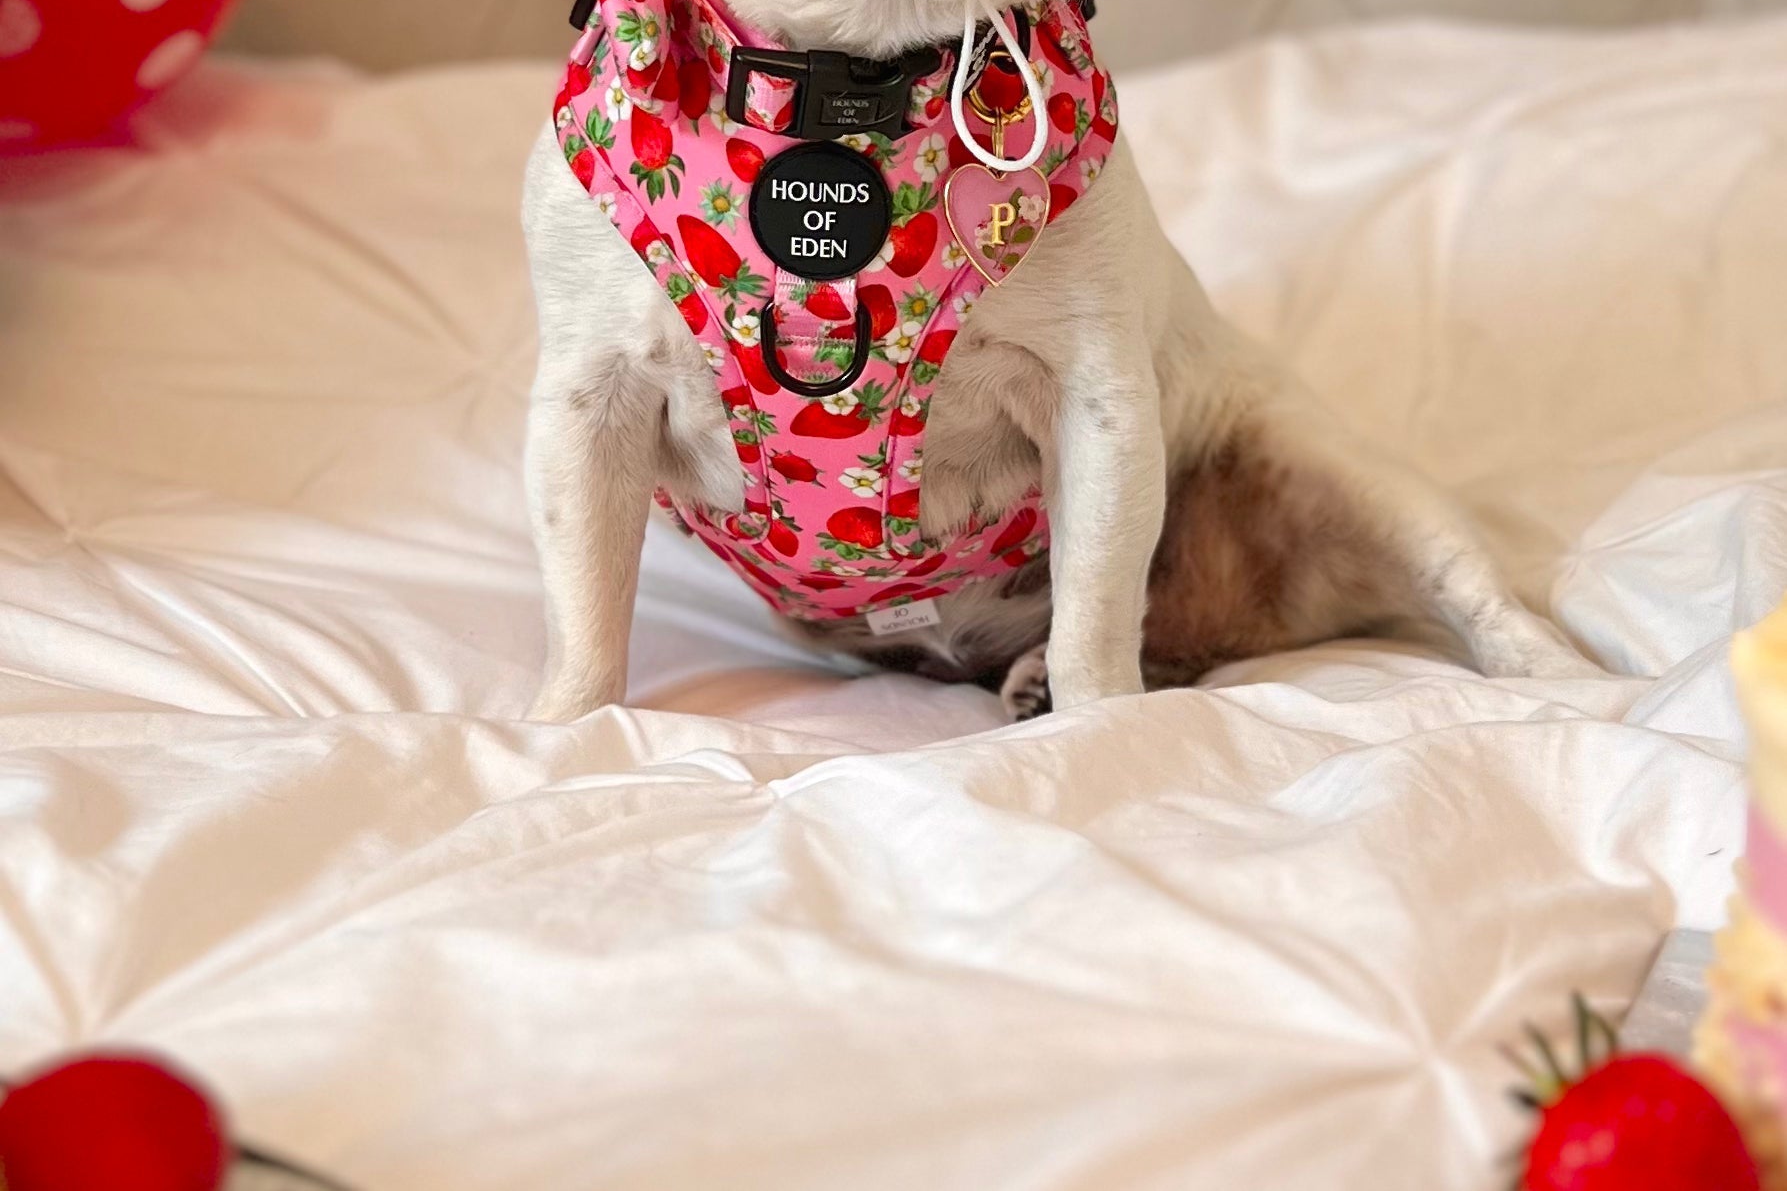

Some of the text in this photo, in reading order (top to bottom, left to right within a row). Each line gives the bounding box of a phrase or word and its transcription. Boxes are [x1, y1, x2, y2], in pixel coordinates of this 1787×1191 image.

[833, 99, 869, 108] HOUNDS
[843, 109, 855, 117] OF
[772, 179, 870, 204] HOUNDS
[803, 211, 837, 231] OF
[988, 202, 1016, 245] P
[790, 236, 847, 259] EDEN
